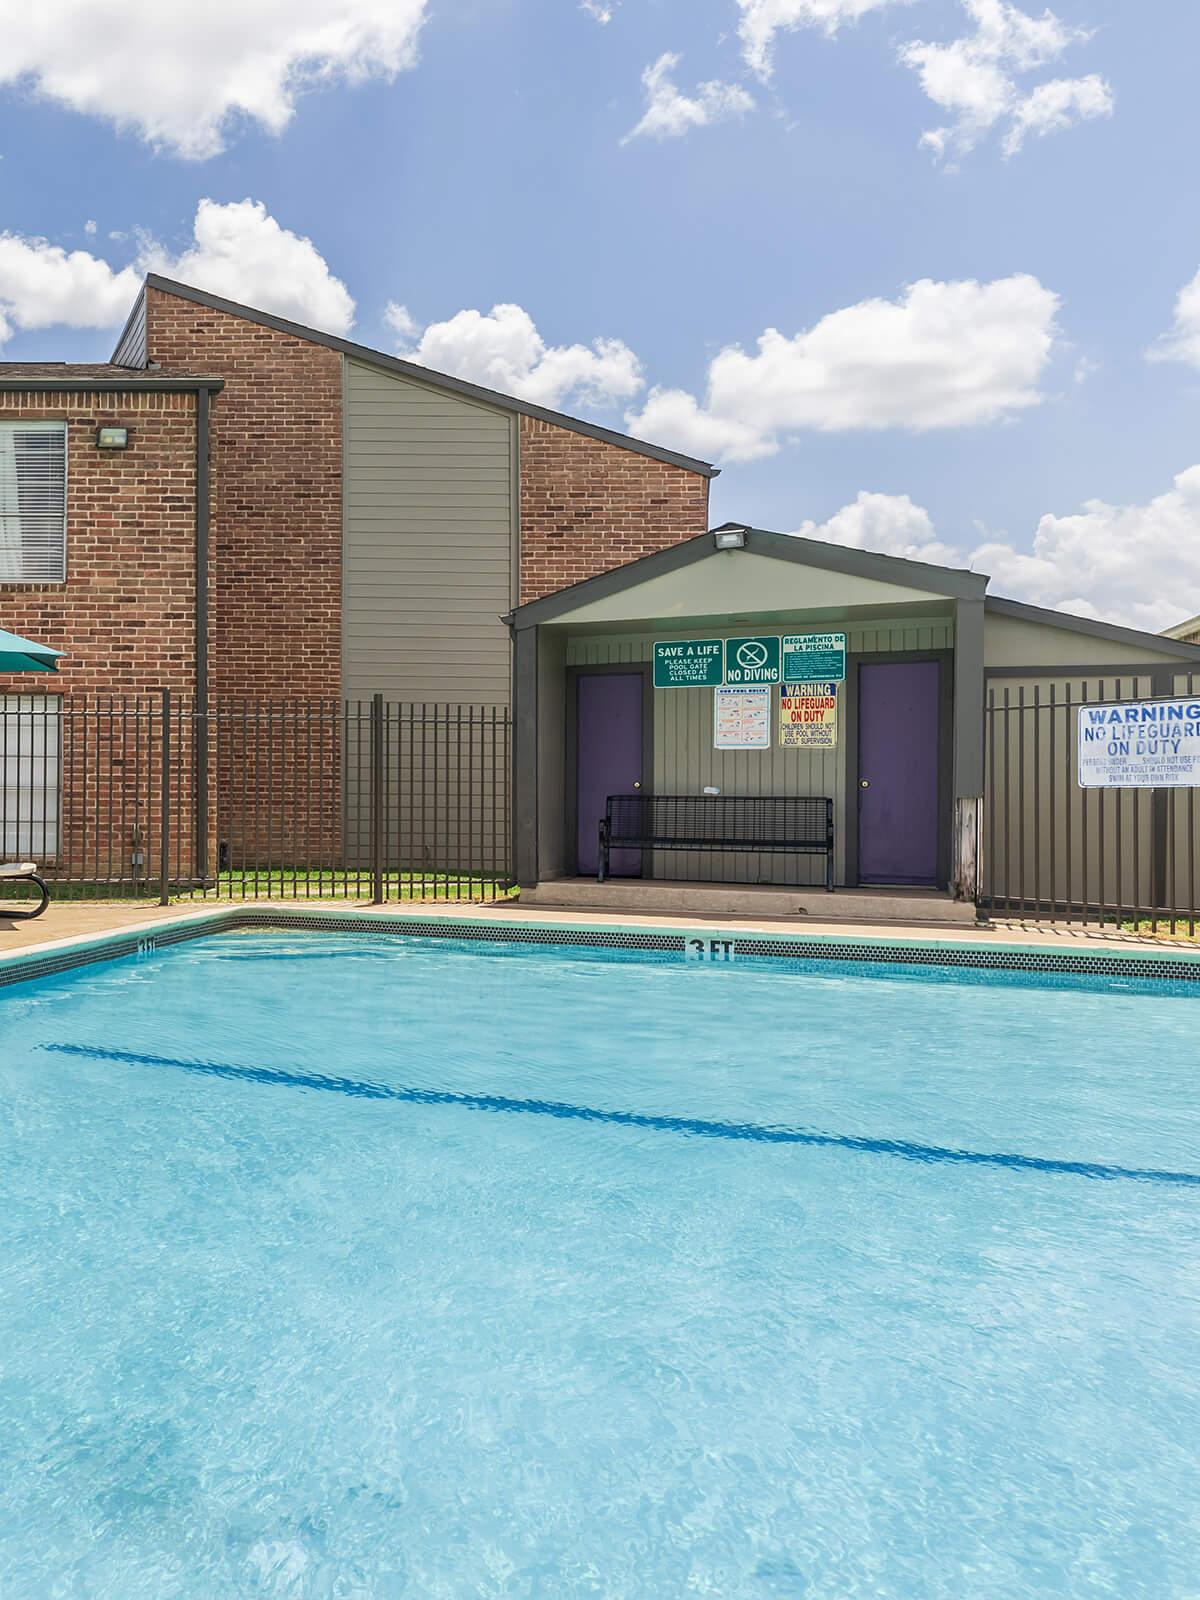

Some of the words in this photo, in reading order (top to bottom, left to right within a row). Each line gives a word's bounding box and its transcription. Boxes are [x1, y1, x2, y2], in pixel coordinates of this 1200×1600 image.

[784, 636, 832, 644] REGLAMENTO
[658, 648, 684, 656] SAVE
[687, 647, 694, 656] A
[697, 645, 719, 655] LIFE
[728, 670, 741, 681] NO
[744, 668, 778, 680] DIVING
[786, 684, 831, 697] WARNING
[782, 698, 792, 710] NO
[795, 697, 834, 709] LIFEGUARD
[791, 711, 802, 722] ON
[804, 710, 824, 722] DUTY
[1089, 704, 1200, 724] WARNING
[1085, 726, 1106, 741] NO
[1108, 741, 1129, 756] ON
[1136, 739, 1181, 755] DUTY
[689, 939, 704, 957] 3
[710, 940, 732, 958] FT
